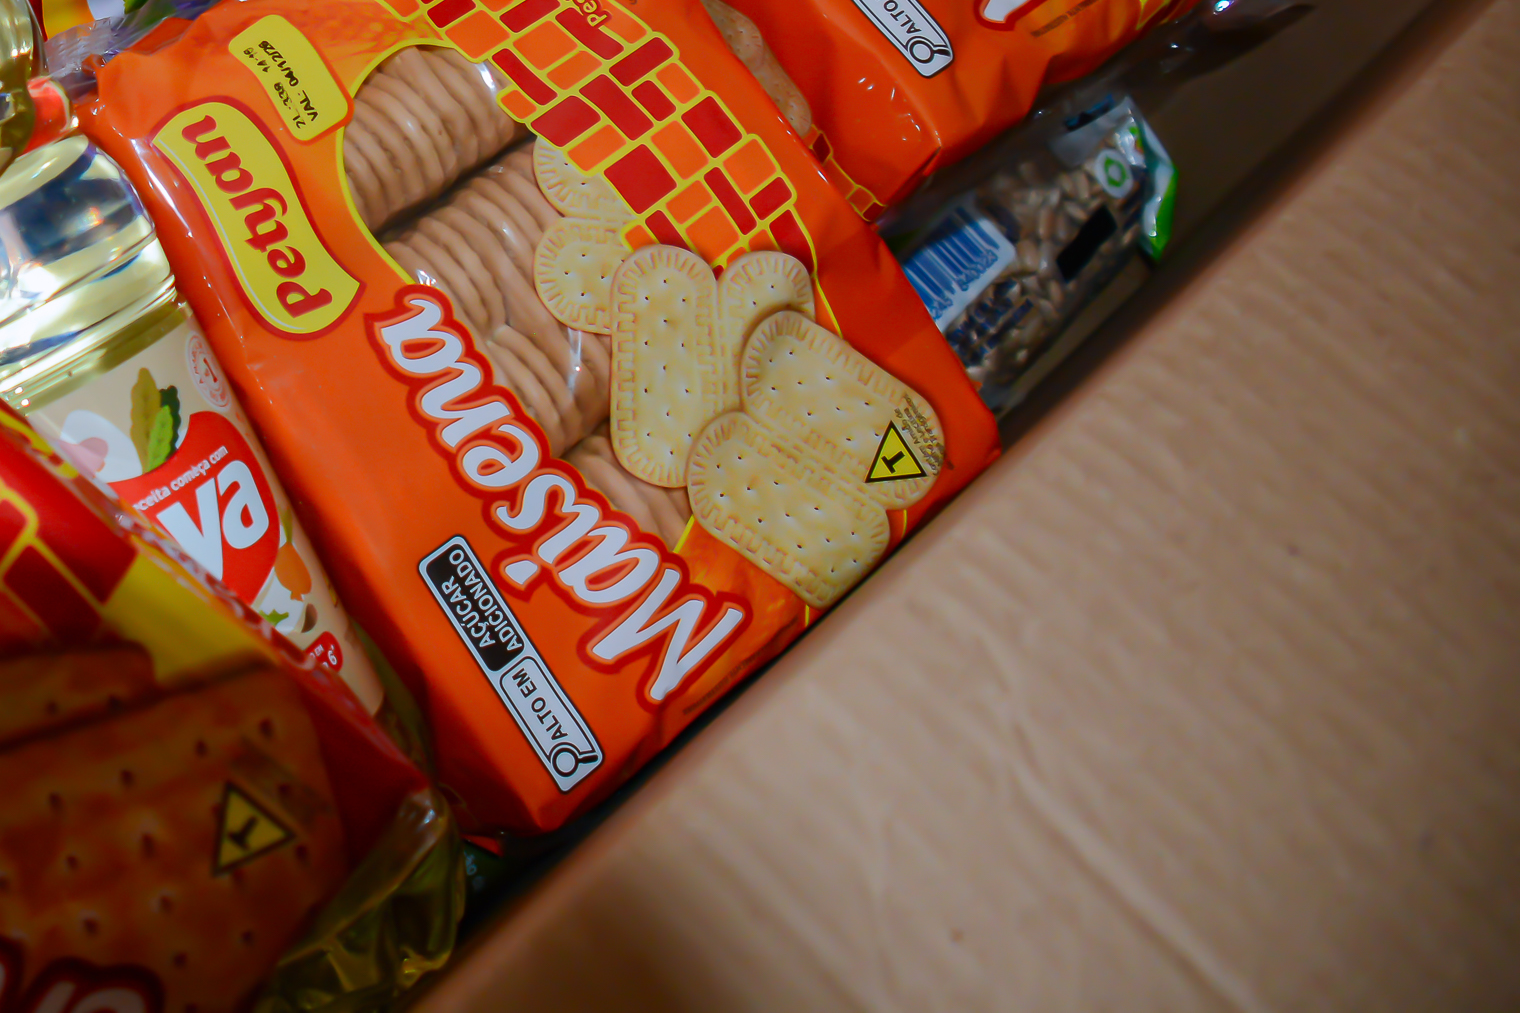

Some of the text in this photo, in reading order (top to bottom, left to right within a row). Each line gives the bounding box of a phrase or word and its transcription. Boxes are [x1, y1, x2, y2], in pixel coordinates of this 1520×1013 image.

[883, 0, 922, 34] ALTO
[181, 115, 334, 318] Petyan
[170, 458, 211, 491] começa
[209, 445, 228, 464] com
[379, 298, 745, 702] Maisena
[441, 576, 495, 647] AÇÚCAR
[449, 549, 522, 651] ADICIONADO
[512, 668, 568, 740] ALTO EM
